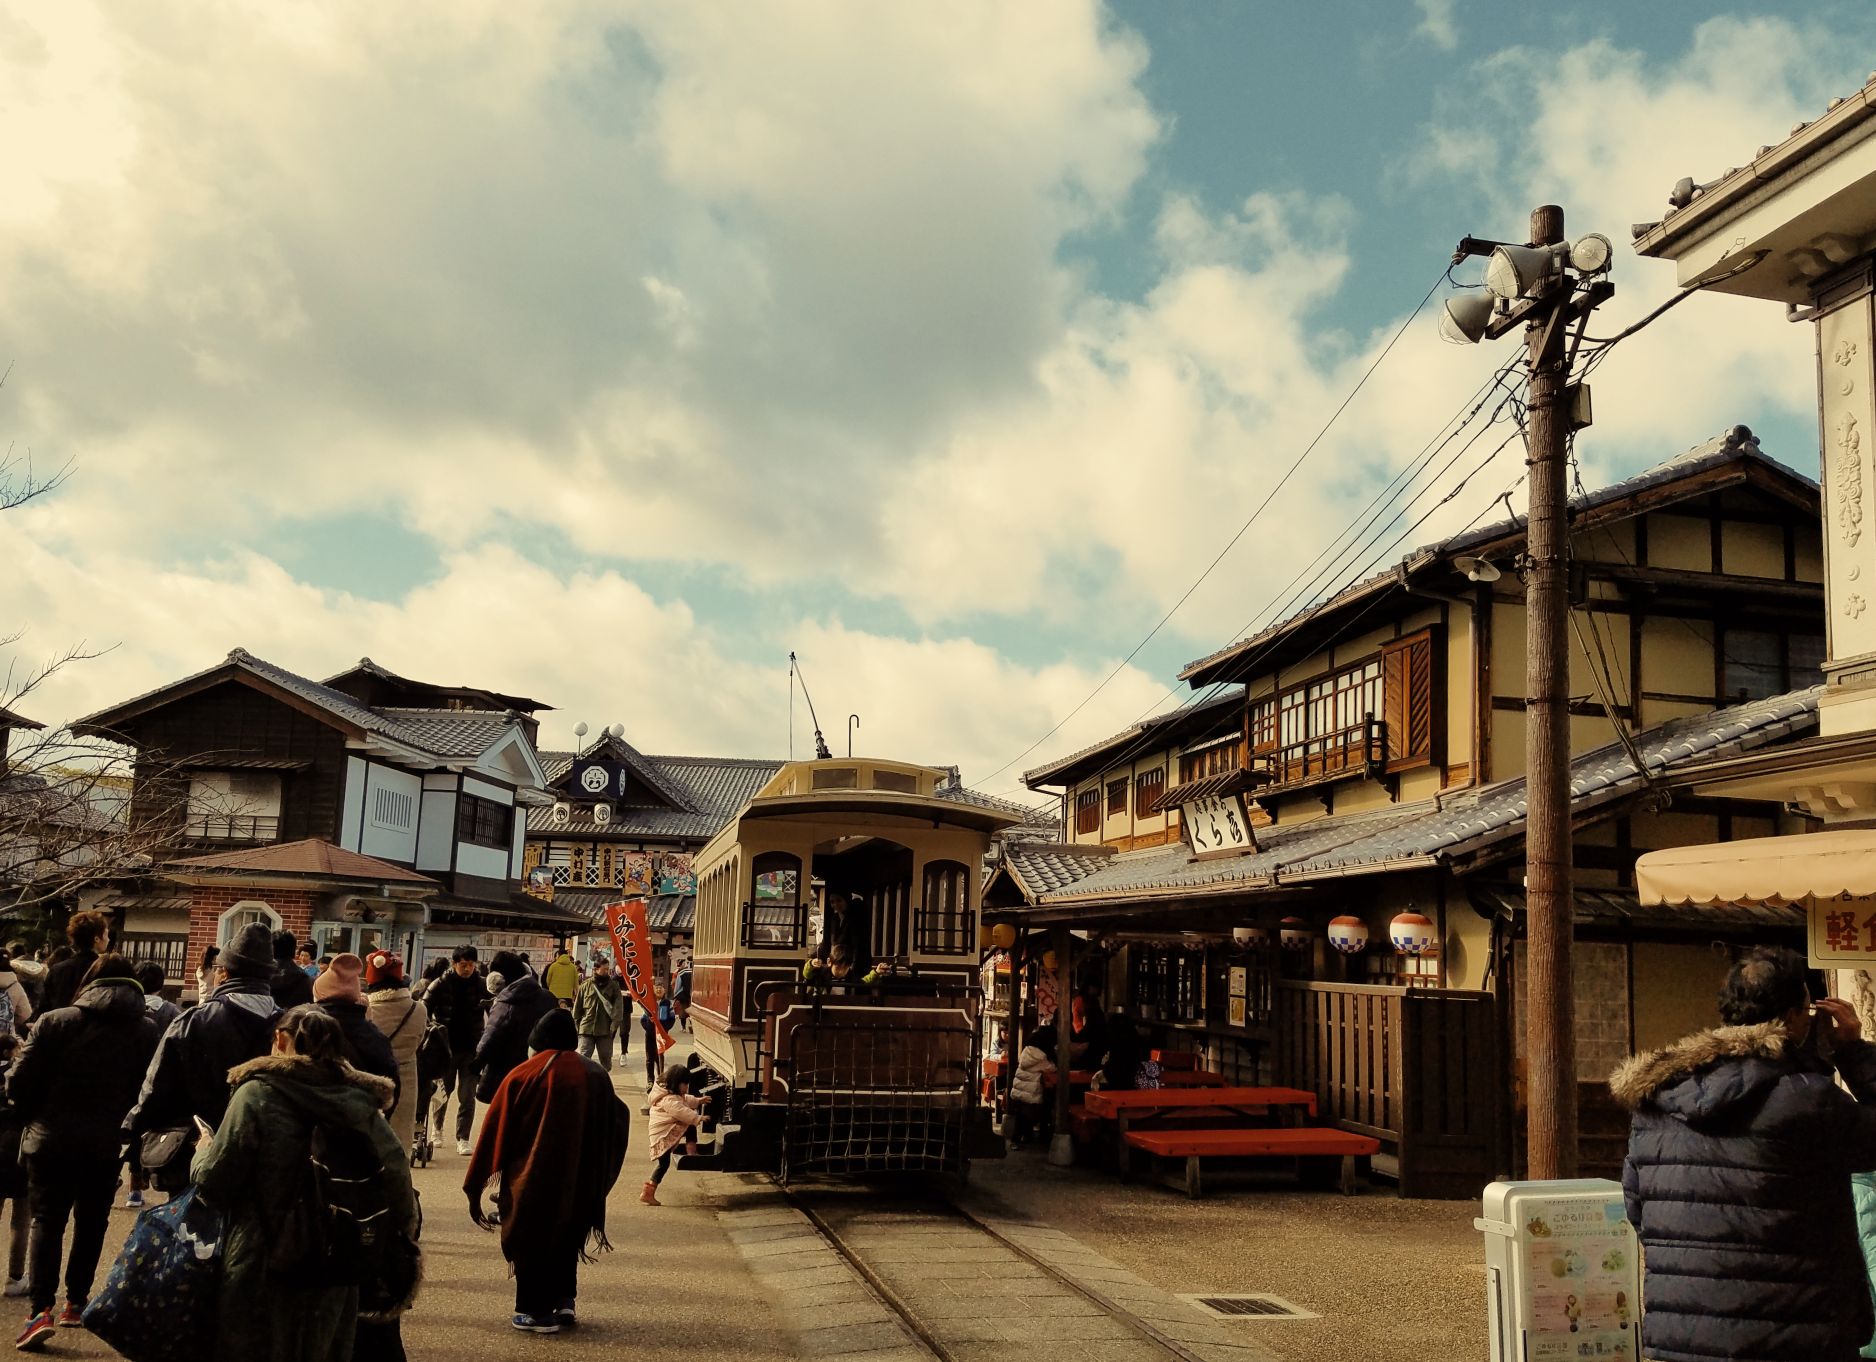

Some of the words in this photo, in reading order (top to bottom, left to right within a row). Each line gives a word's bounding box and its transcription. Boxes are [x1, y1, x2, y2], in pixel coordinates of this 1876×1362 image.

[572, 847, 585, 882] 中村座
[614, 912, 649, 1000] みたらし
